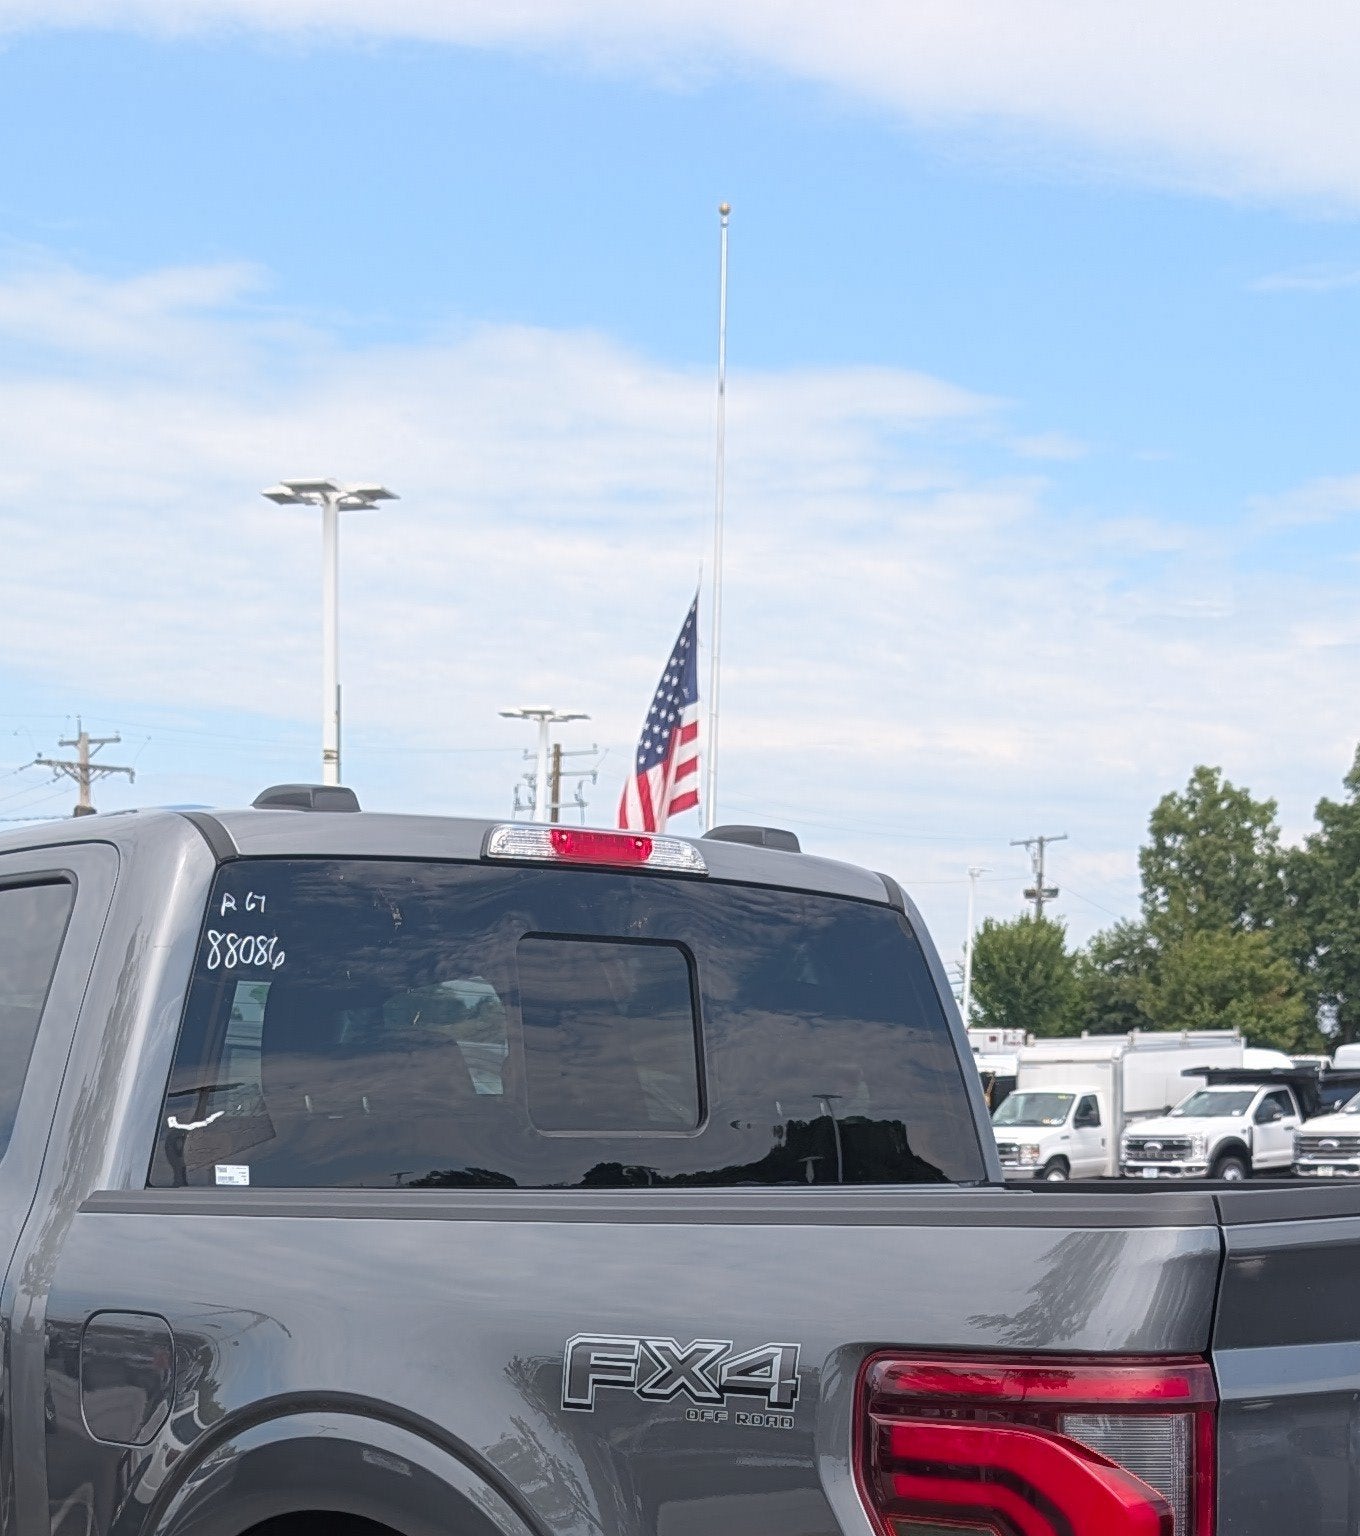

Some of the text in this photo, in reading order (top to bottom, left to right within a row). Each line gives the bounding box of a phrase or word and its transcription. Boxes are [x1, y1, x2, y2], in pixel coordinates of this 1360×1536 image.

[207, 929, 285, 970] 88086
[561, 1332, 801, 1413] FX4
[685, 1408, 795, 1430] OFF ROAD
